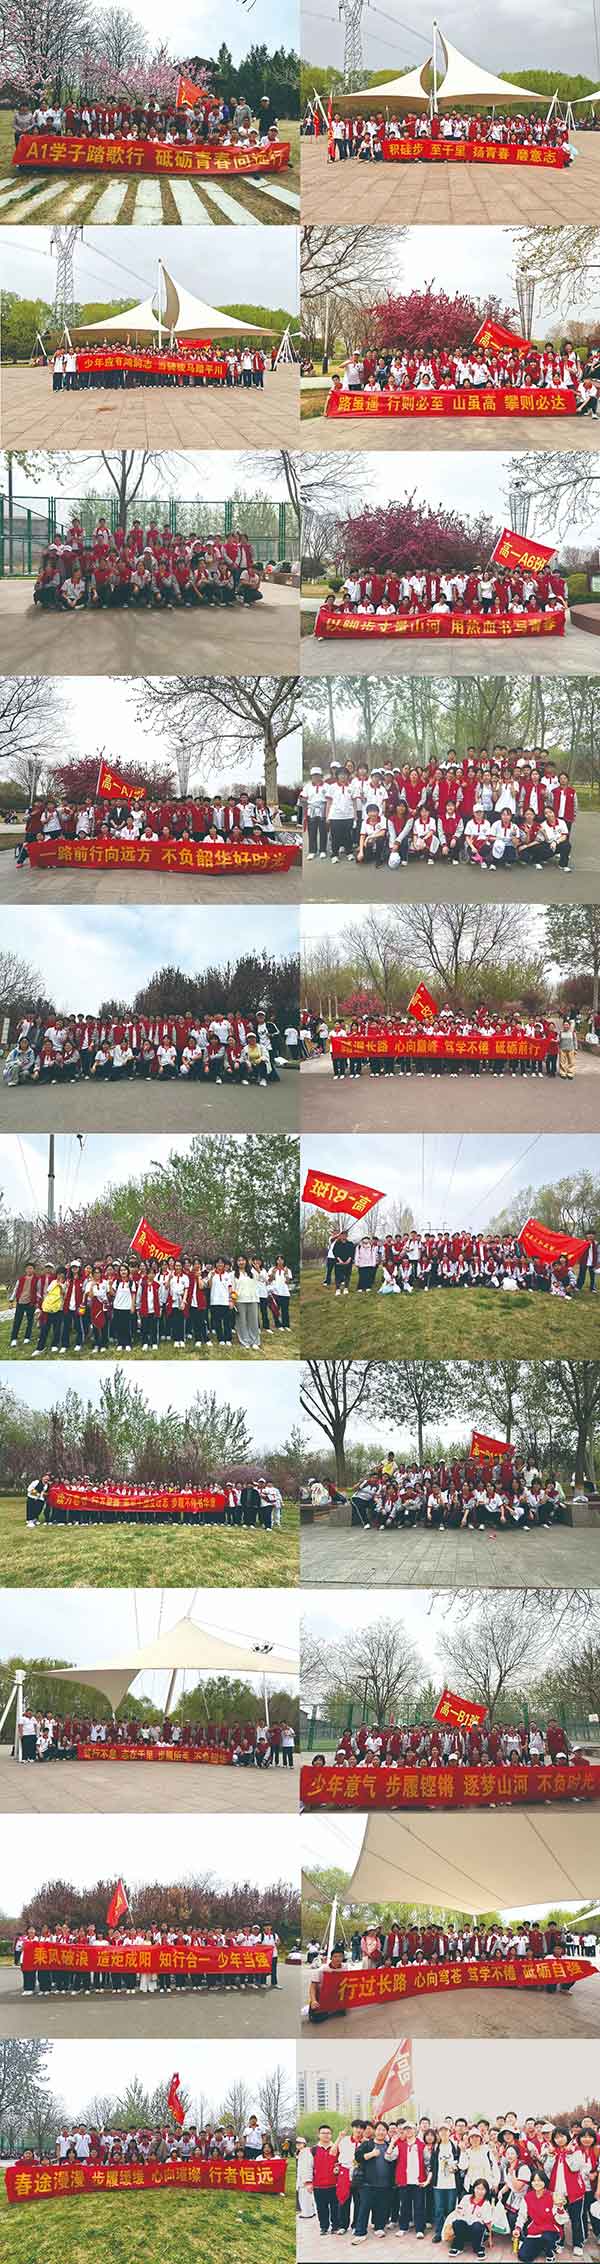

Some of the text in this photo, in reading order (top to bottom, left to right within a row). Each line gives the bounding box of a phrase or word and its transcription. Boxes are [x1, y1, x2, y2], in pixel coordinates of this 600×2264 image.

[26, 142, 145, 165] A1学子踏歌行
[431, 144, 466, 157] 至千里
[387, 395, 444, 412] 行则必至
[453, 395, 496, 411] 山虽高
[504, 395, 566, 411] 攀则必达
[498, 541, 547, 572] 高一A6班
[450, 616, 557, 635] 用热血书写青春
[39, 845, 287, 868] 一路前行向远方 不负韶华好时光
[495, 1040, 541, 1056] 砥砺前行
[307, 1773, 595, 1799] 少年意气 步履铿锵 逐梦山河 不负时光
[33, 1947, 89, 1967] 乘风破浪
[159, 1950, 211, 1969] 知行合一
[217, 1950, 270, 1969] 少年当强
[338, 1973, 407, 2000] 行过长路
[414, 1967, 462, 1988] 心向穹苍
[522, 1959, 583, 1979] 砥砺自强
[208, 2166, 274, 2185] 行者恒远
